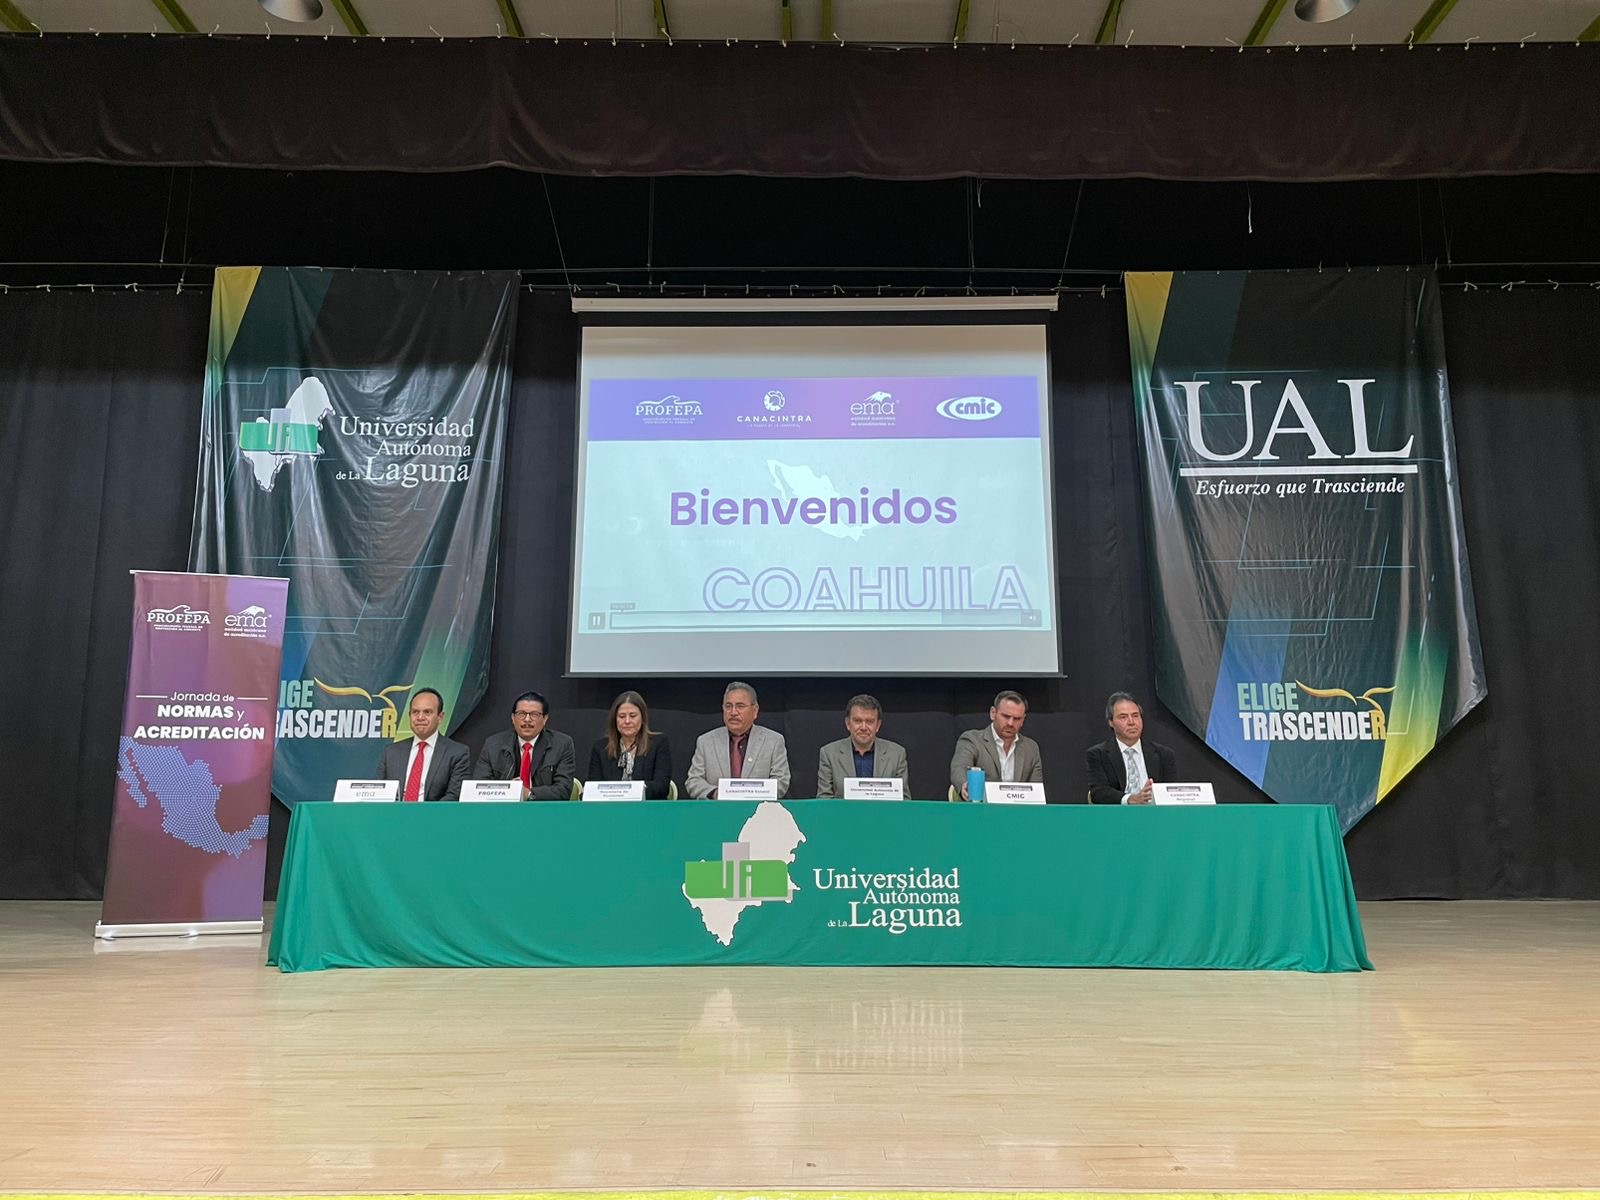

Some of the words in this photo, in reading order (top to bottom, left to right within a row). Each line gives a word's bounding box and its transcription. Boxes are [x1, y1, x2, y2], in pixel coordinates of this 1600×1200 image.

[635, 405, 704, 416] PROFEPA
[850, 401, 895, 415] ema
[955, 398, 996, 415] cmic
[339, 416, 474, 438] Universidad
[737, 415, 812, 423] CANACINTRA
[1173, 378, 1415, 461] UAL
[375, 439, 471, 457] Autónoma
[336, 471, 347, 480] de
[348, 471, 360, 480] La
[364, 456, 470, 487] Laguna
[1195, 479, 1271, 498] Esfuerzo
[1276, 482, 1307, 498] que
[1312, 477, 1405, 494] Trasciende
[670, 487, 958, 526] Bienvenidos
[703, 565, 1034, 612] COAHUILA
[147, 612, 211, 624] PROFEPA
[224, 614, 267, 628] ema
[170, 692, 220, 702] Jornada
[222, 694, 235, 702] de
[279, 680, 315, 708] IGE
[1237, 682, 1299, 711] ELIGE
[157, 704, 234, 718] NORMAS
[236, 710, 245, 721] y
[275, 708, 398, 738] ASCENDER
[133, 723, 265, 740] ACREDITACIÓN
[1239, 711, 1387, 740] TRASCENDER
[813, 867, 960, 889] Universidad
[863, 888, 960, 904] Autónoma
[827, 919, 837, 927] de
[837, 919, 847, 927] La
[848, 901, 963, 934] Laguna
